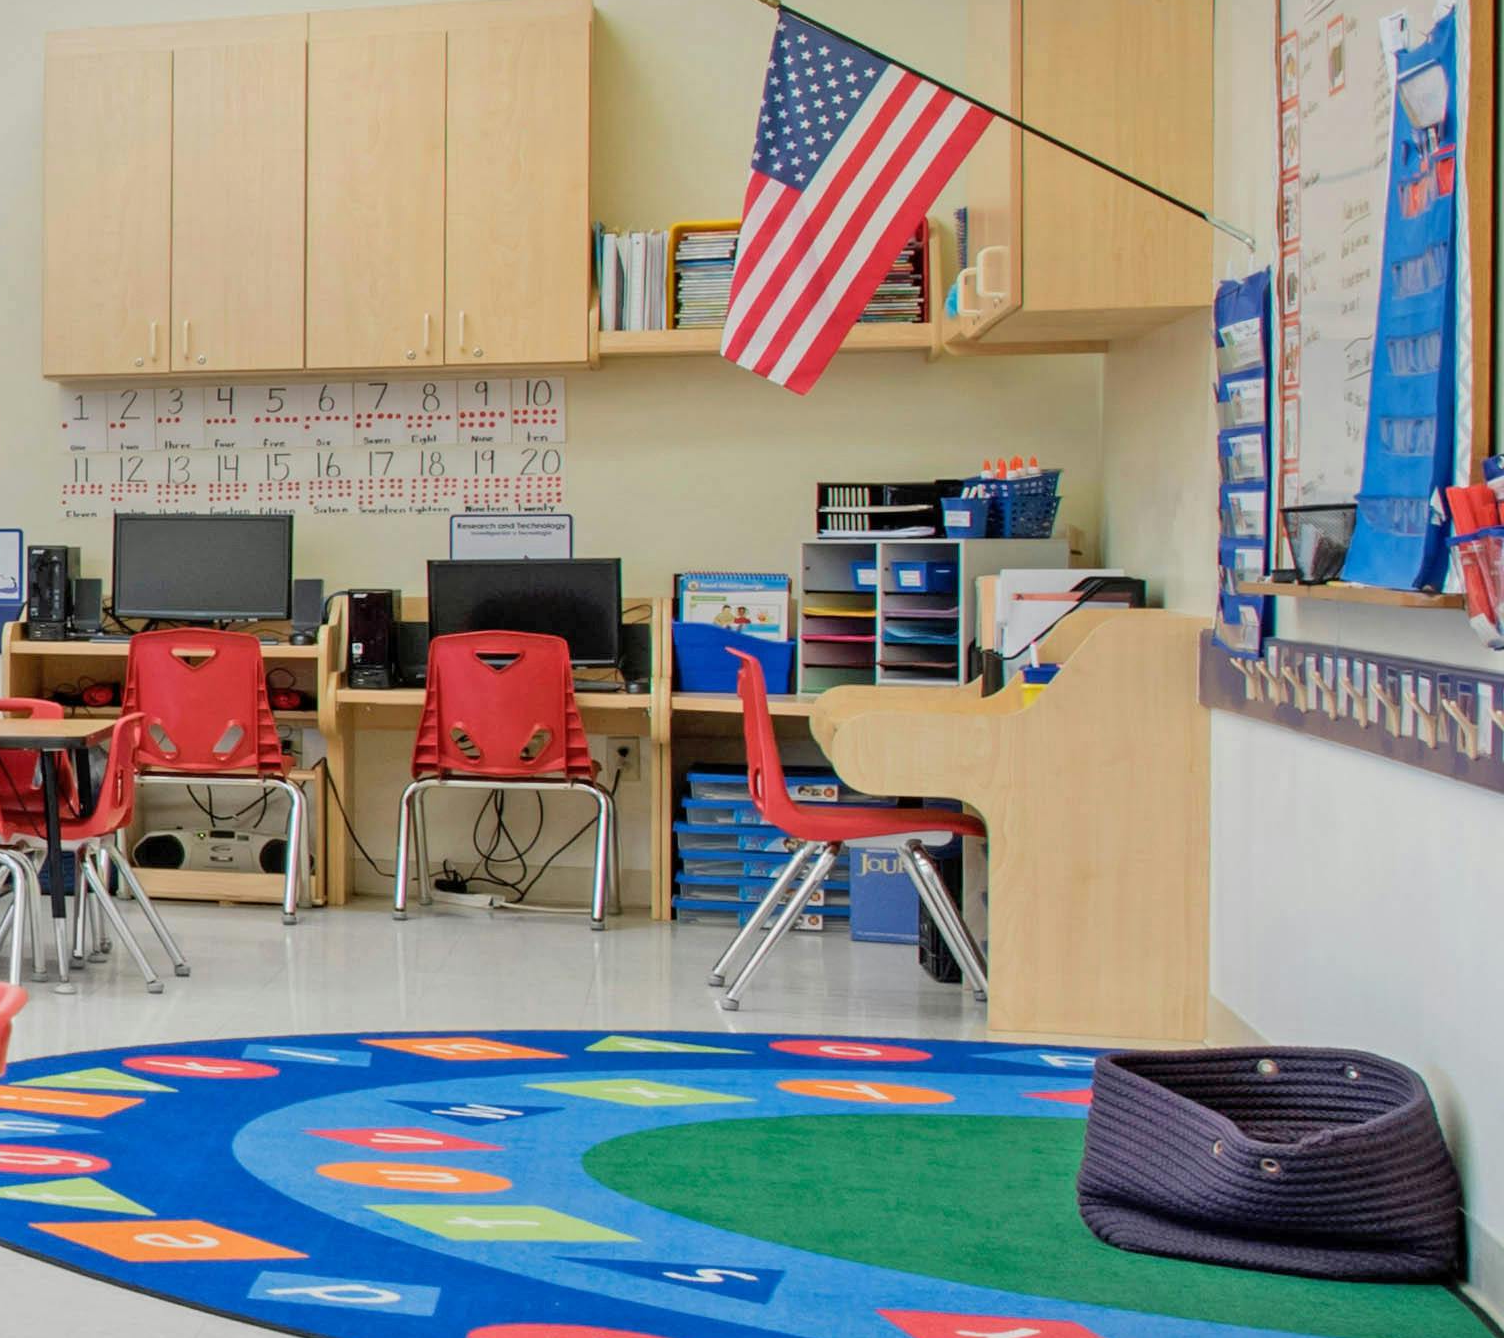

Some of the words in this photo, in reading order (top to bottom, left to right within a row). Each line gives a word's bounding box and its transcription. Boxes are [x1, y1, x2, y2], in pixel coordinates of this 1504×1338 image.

[120, 389, 141, 420] 2
[167, 388, 184, 415] 3
[216, 386, 234, 415] 4
[265, 388, 287, 413] 5
[318, 384, 335, 412] 6
[368, 382, 388, 410] 7
[422, 383, 441, 412] 8
[475, 381, 489, 406] 9
[525, 380, 552, 406] 10
[73, 394, 89, 421] 1
[74, 457, 89, 483] 11
[119, 455, 147, 482] 12
[167, 455, 191, 484] 13
[217, 454, 239, 482] 14
[266, 453, 292, 482] 15
[316, 452, 341, 478] 16
[369, 451, 394, 476] 17
[420, 450, 445, 477] 18
[474, 449, 495, 475] 19
[520, 448, 561, 476] 20
